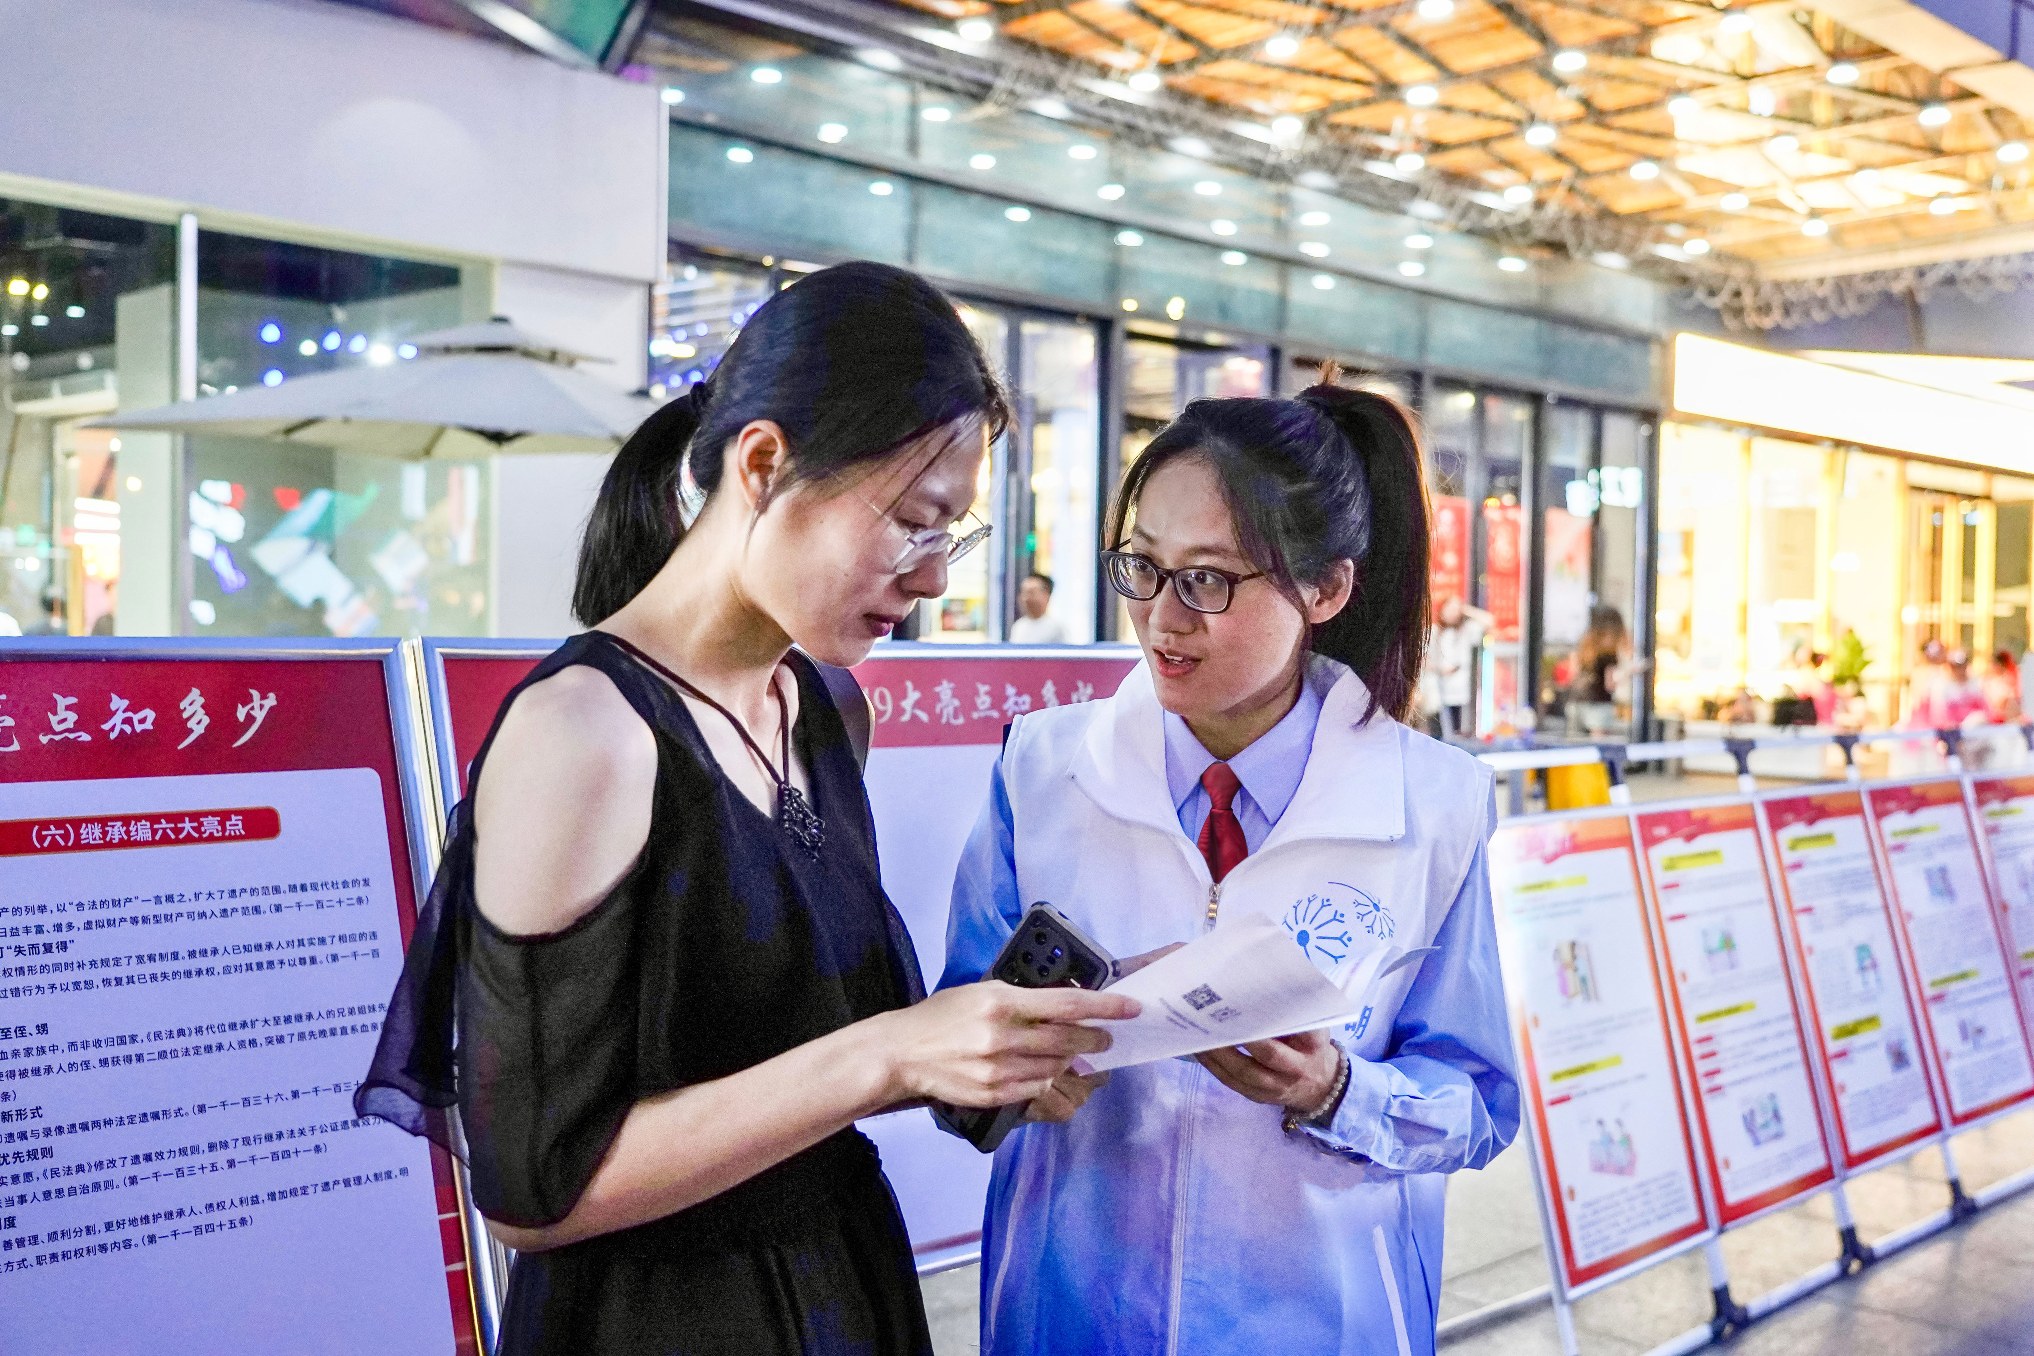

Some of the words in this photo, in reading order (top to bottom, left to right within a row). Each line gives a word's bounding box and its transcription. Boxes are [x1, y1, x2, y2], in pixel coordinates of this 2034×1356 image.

[32, 814, 246, 849] （六）继承编六大亮点
[1, 1105, 43, 1124] 新形式
